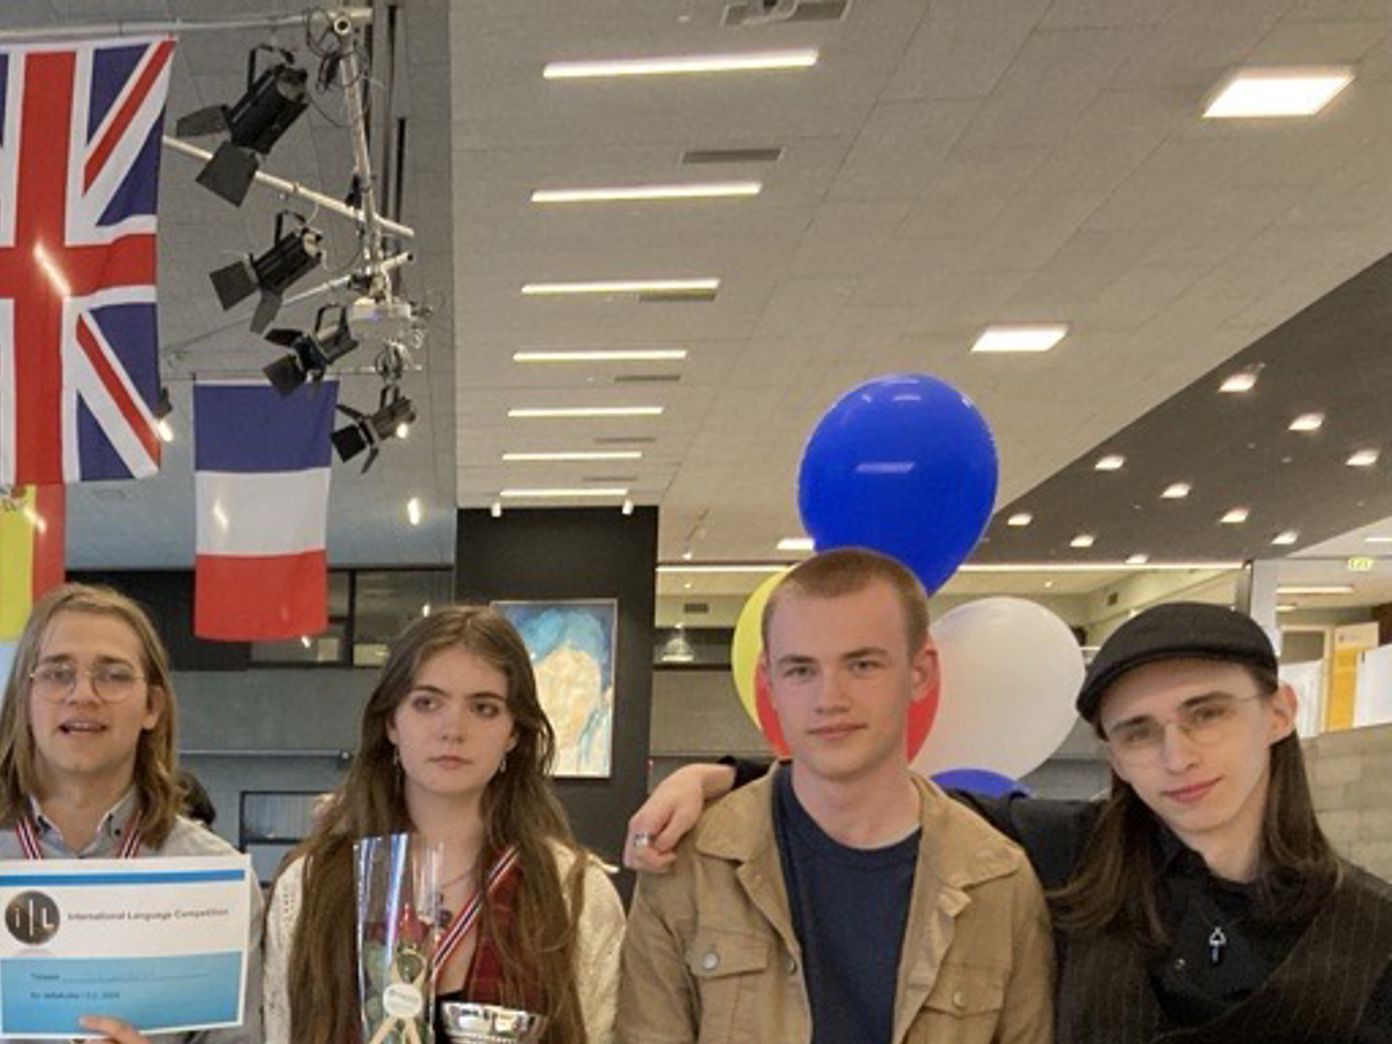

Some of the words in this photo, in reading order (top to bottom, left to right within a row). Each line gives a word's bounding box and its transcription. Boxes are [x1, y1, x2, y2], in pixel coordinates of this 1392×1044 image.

[67, 910, 126, 921] International
[127, 910, 172, 922] Language
[174, 907, 229, 919] Competition
